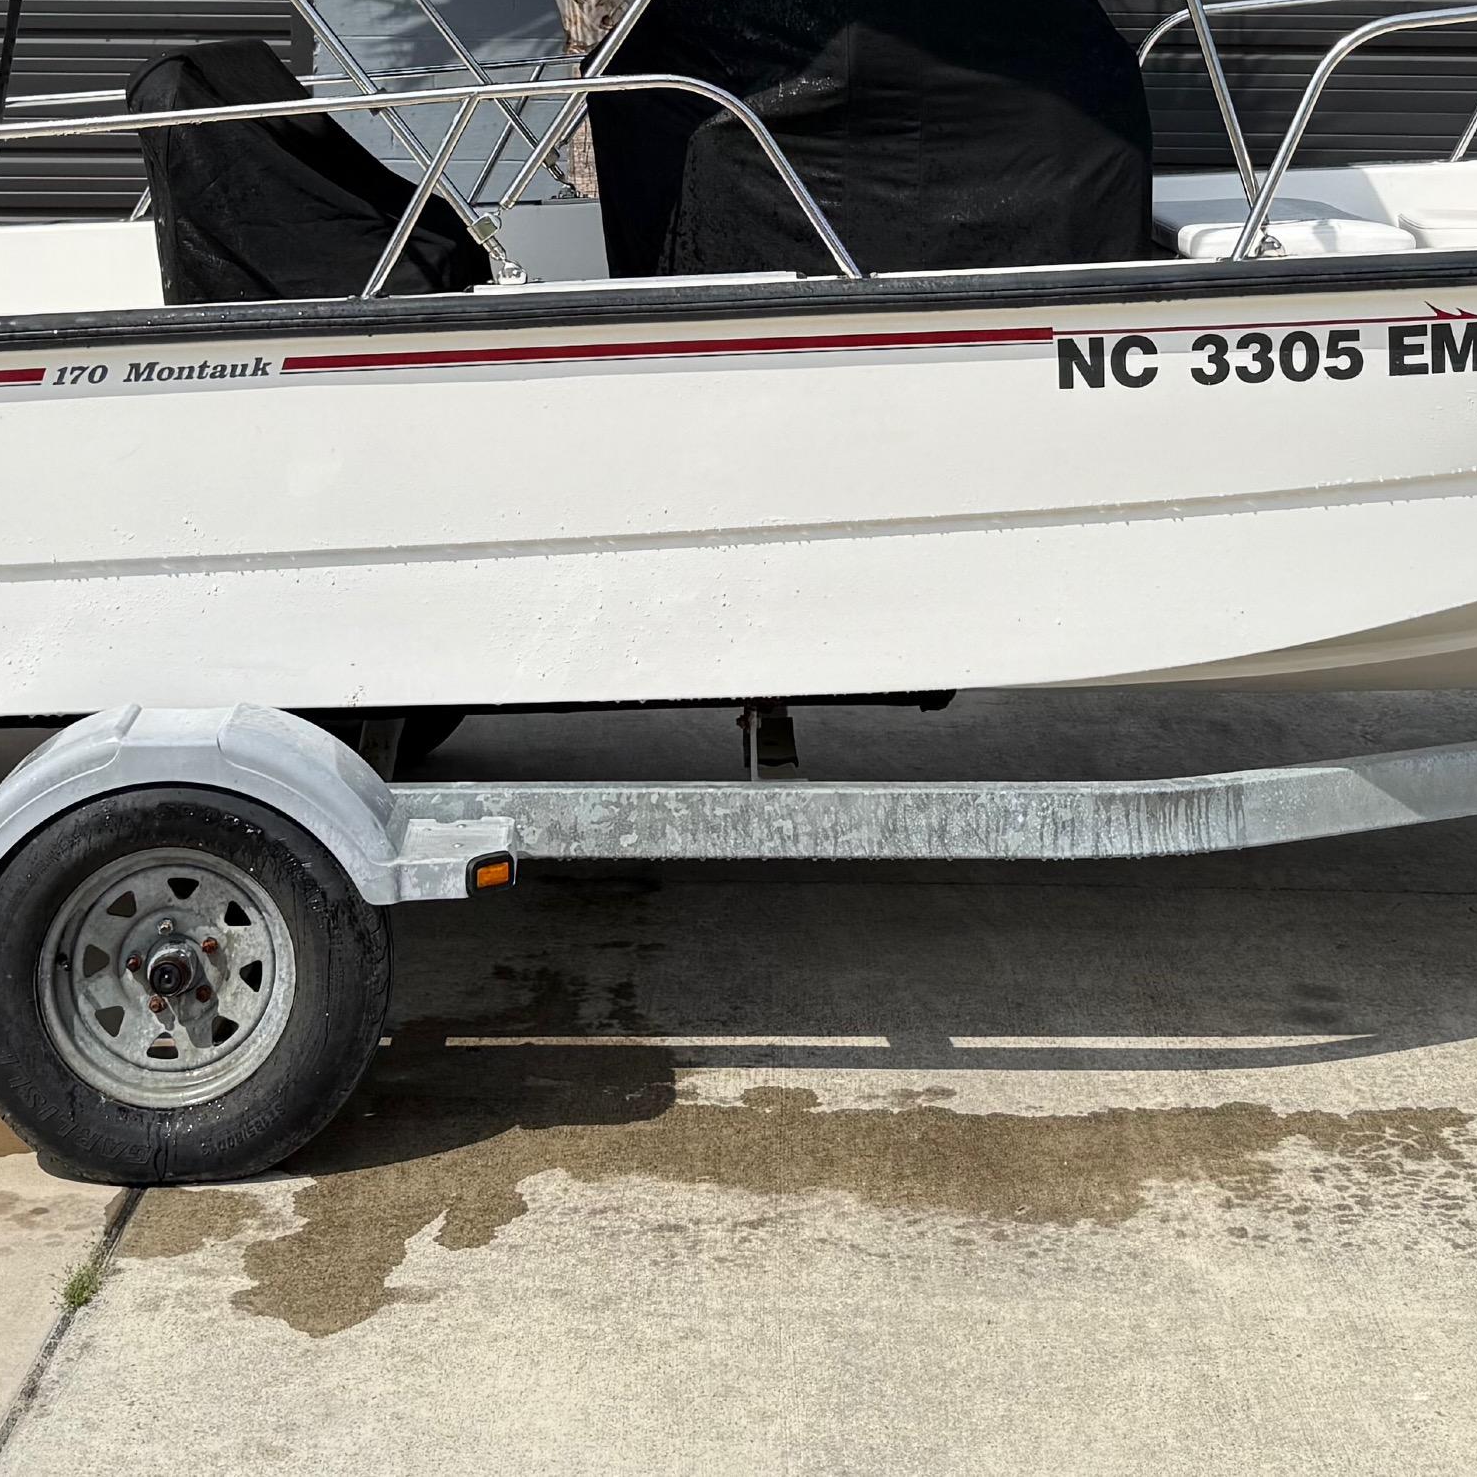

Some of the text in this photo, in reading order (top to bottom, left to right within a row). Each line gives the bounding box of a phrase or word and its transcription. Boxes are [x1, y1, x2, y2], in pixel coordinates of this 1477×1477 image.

[52, 356, 273, 386] 170 Montauk
[1057, 334, 1159, 390] NC
[1190, 329, 1364, 385] 3305
